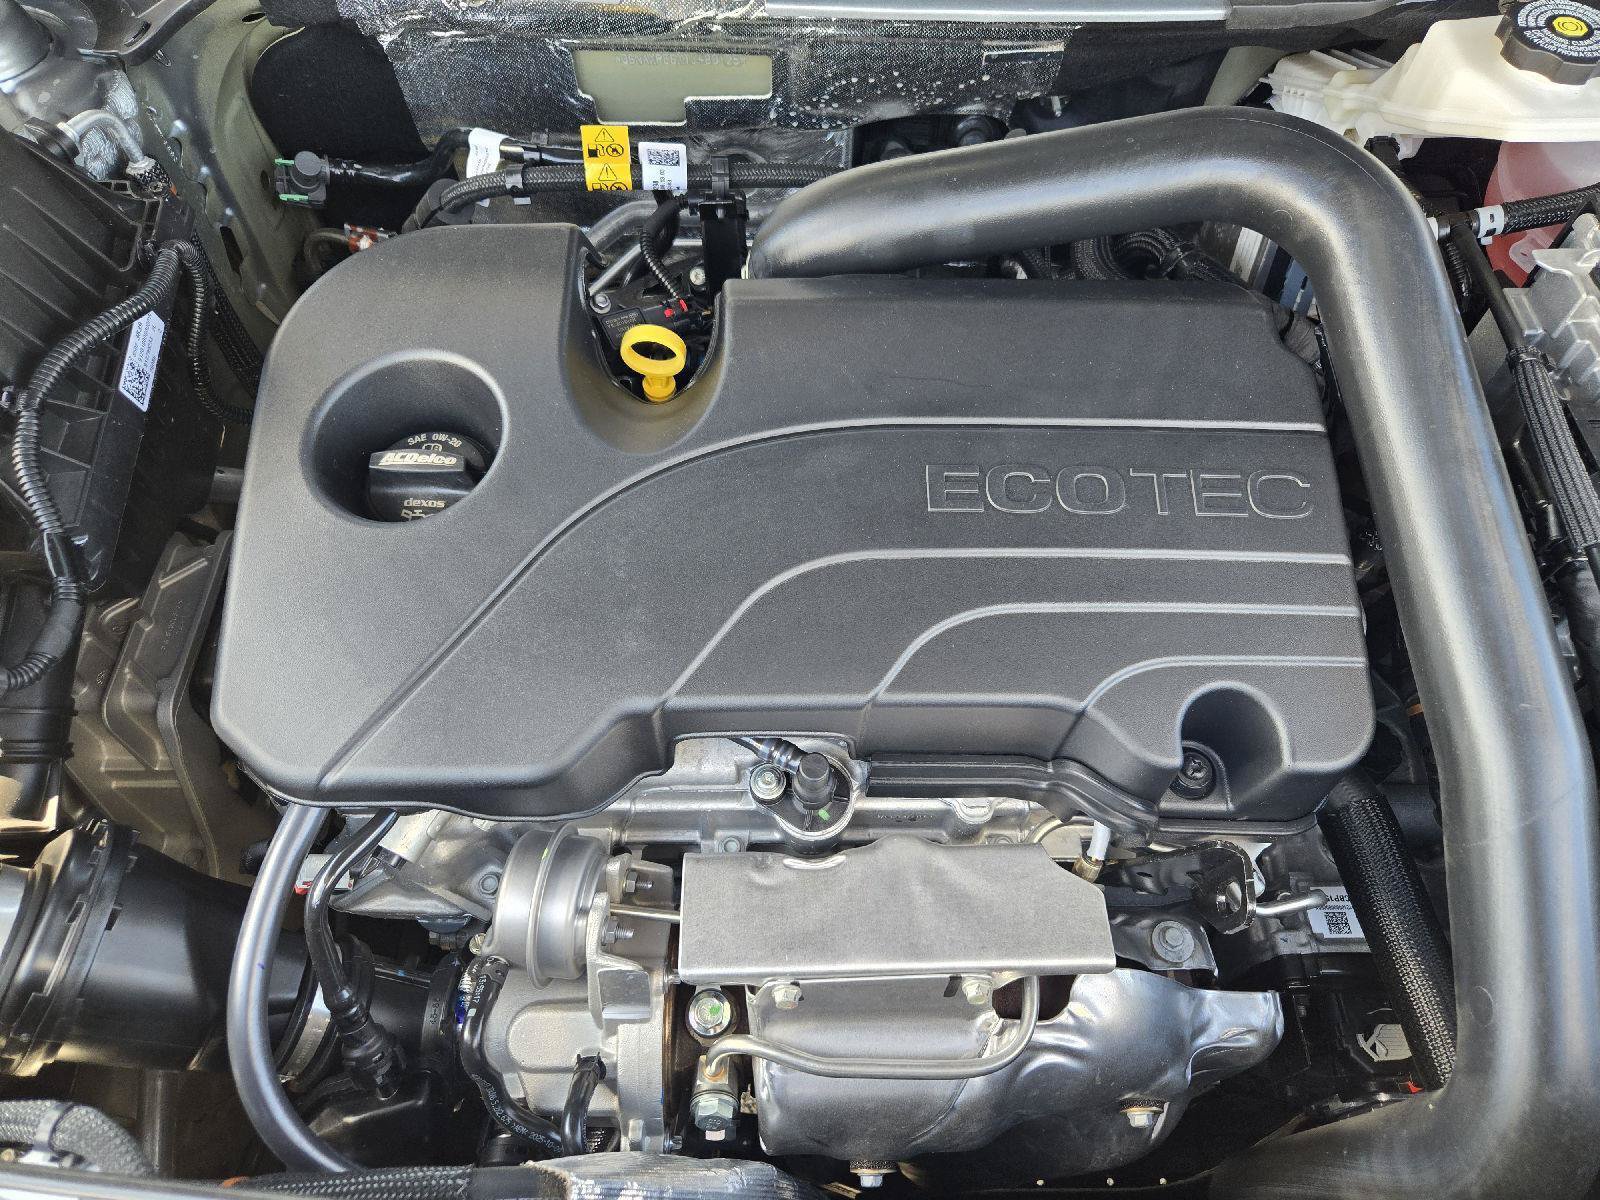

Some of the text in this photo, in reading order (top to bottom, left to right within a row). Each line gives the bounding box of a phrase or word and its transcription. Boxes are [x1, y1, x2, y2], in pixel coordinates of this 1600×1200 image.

[407, 433, 462, 448] SAE 0W-20
[379, 452, 457, 466] ACDelco
[925, 465, 1314, 520] ECOTEC
[403, 497, 446, 508] dexos
